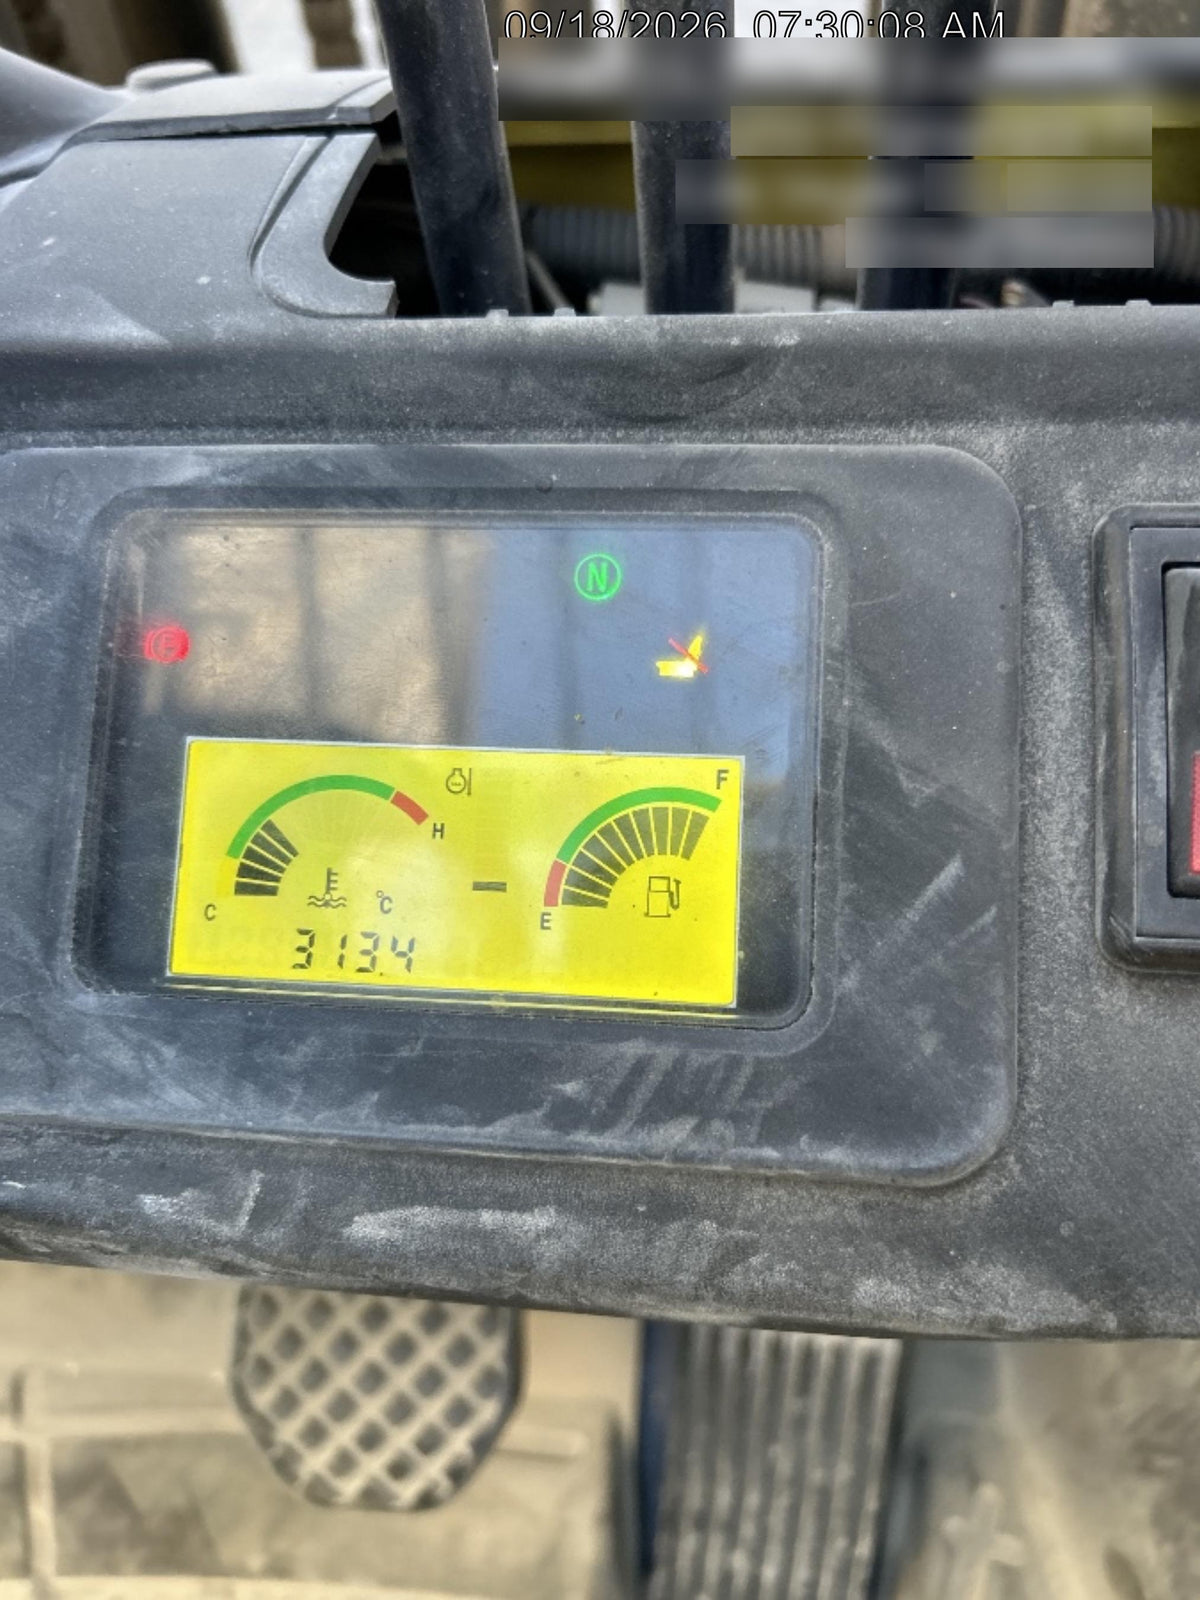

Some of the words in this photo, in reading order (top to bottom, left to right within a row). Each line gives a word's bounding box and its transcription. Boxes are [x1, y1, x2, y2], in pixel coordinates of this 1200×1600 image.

[716, 769, 729, 790] F
[432, 822, 445, 840] H
[204, 903, 216, 921] C
[540, 911, 552, 930] E
